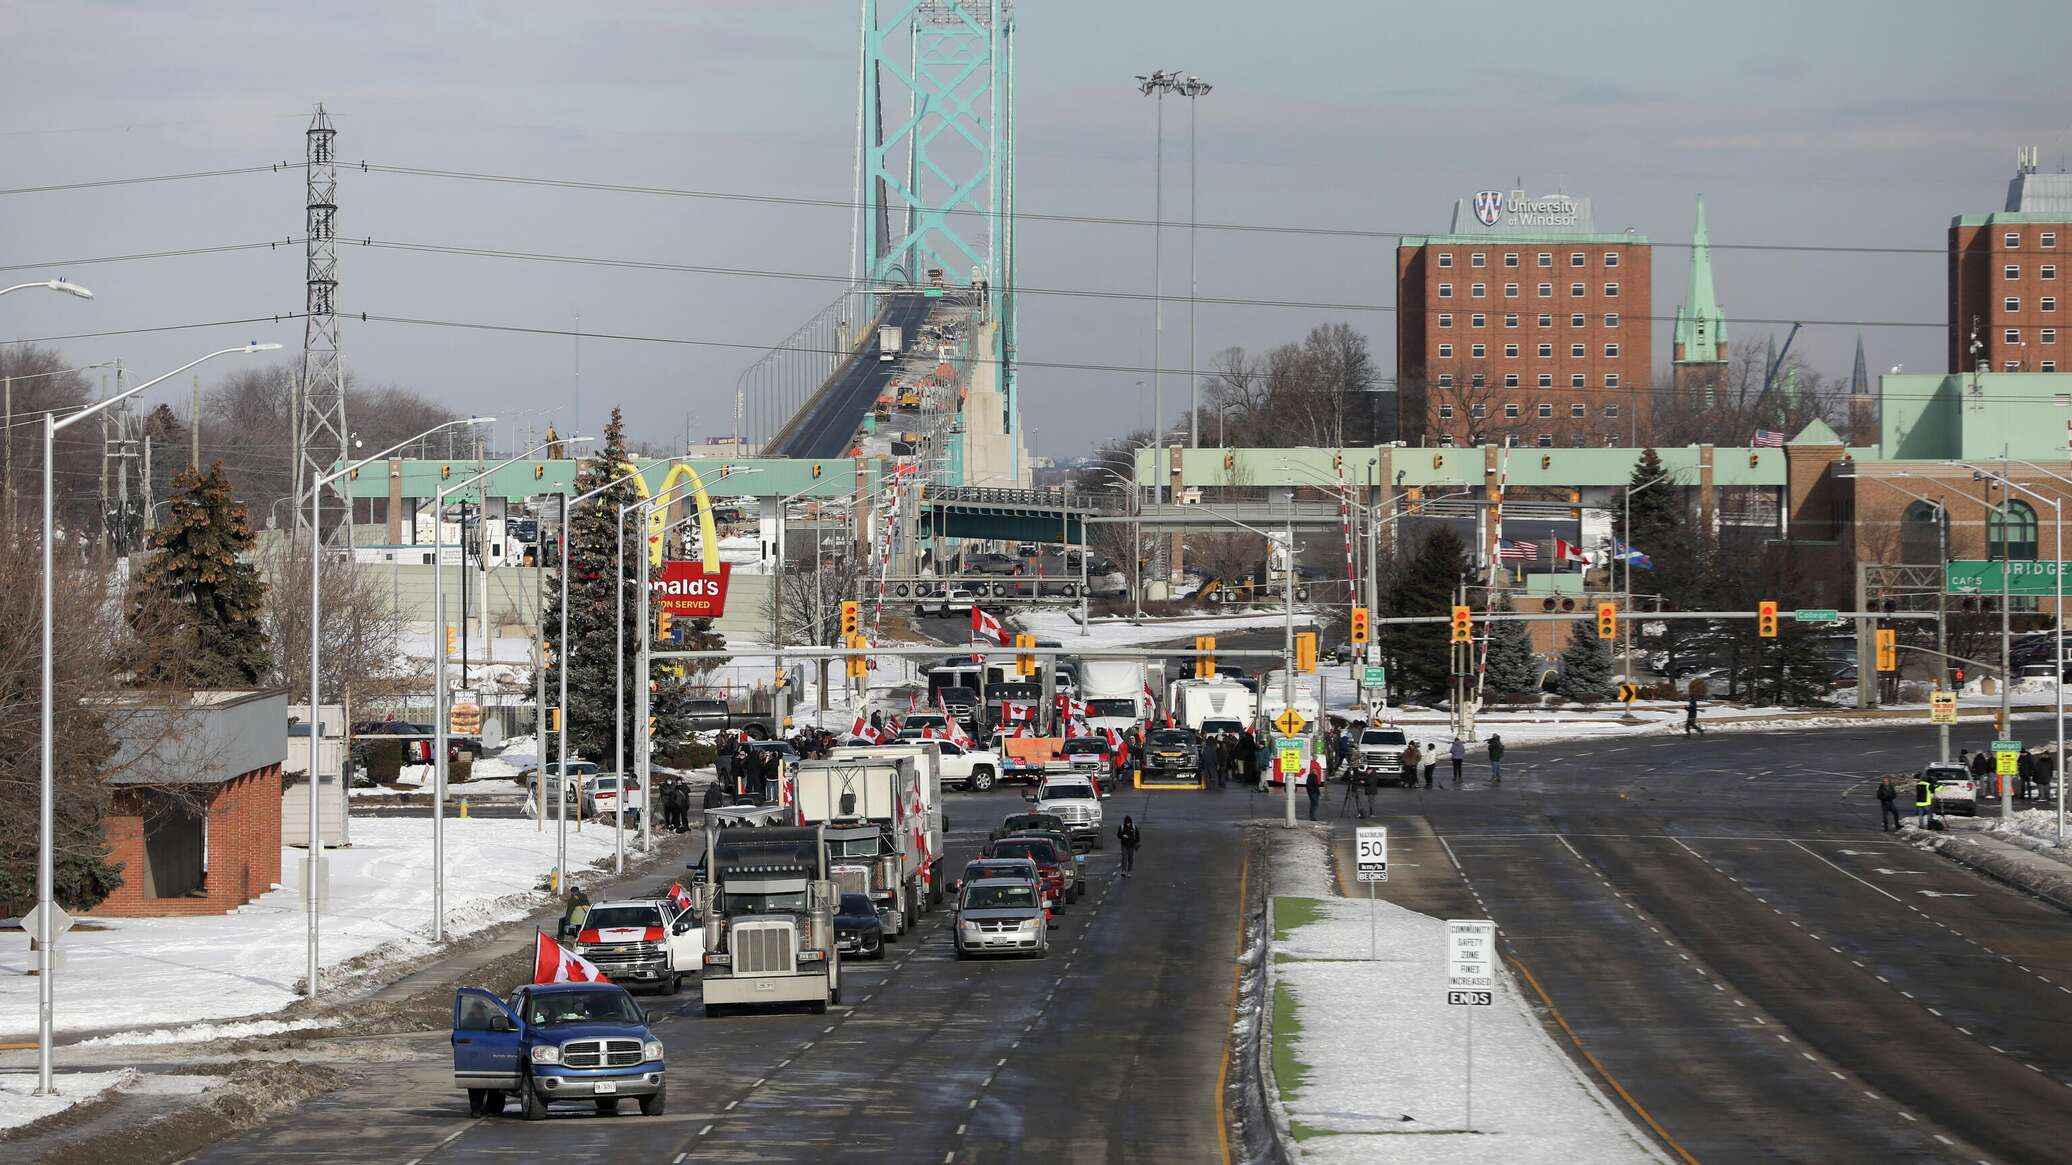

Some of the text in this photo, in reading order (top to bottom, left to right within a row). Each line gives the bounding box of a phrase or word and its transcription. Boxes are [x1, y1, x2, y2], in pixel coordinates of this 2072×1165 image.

[1507, 200, 1577, 214] University
[1519, 213, 1576, 225] Windsor
[2002, 563, 2069, 575] BRIDGE
[1952, 576, 1983, 585] CARS
[1799, 611, 1827, 620] College
[1992, 742, 2016, 751] College
[1361, 841, 1382, 857] 50
[1360, 872, 1387, 880] BEGINS
[1452, 926, 1491, 934] COMMUNITY
[1458, 938, 1482, 946] SAFETY
[1460, 950, 1480, 959] ZONE
[1461, 965, 1480, 974] FINES
[1449, 977, 1492, 985] INCREASED
[1450, 993, 1489, 1005] ENDS
